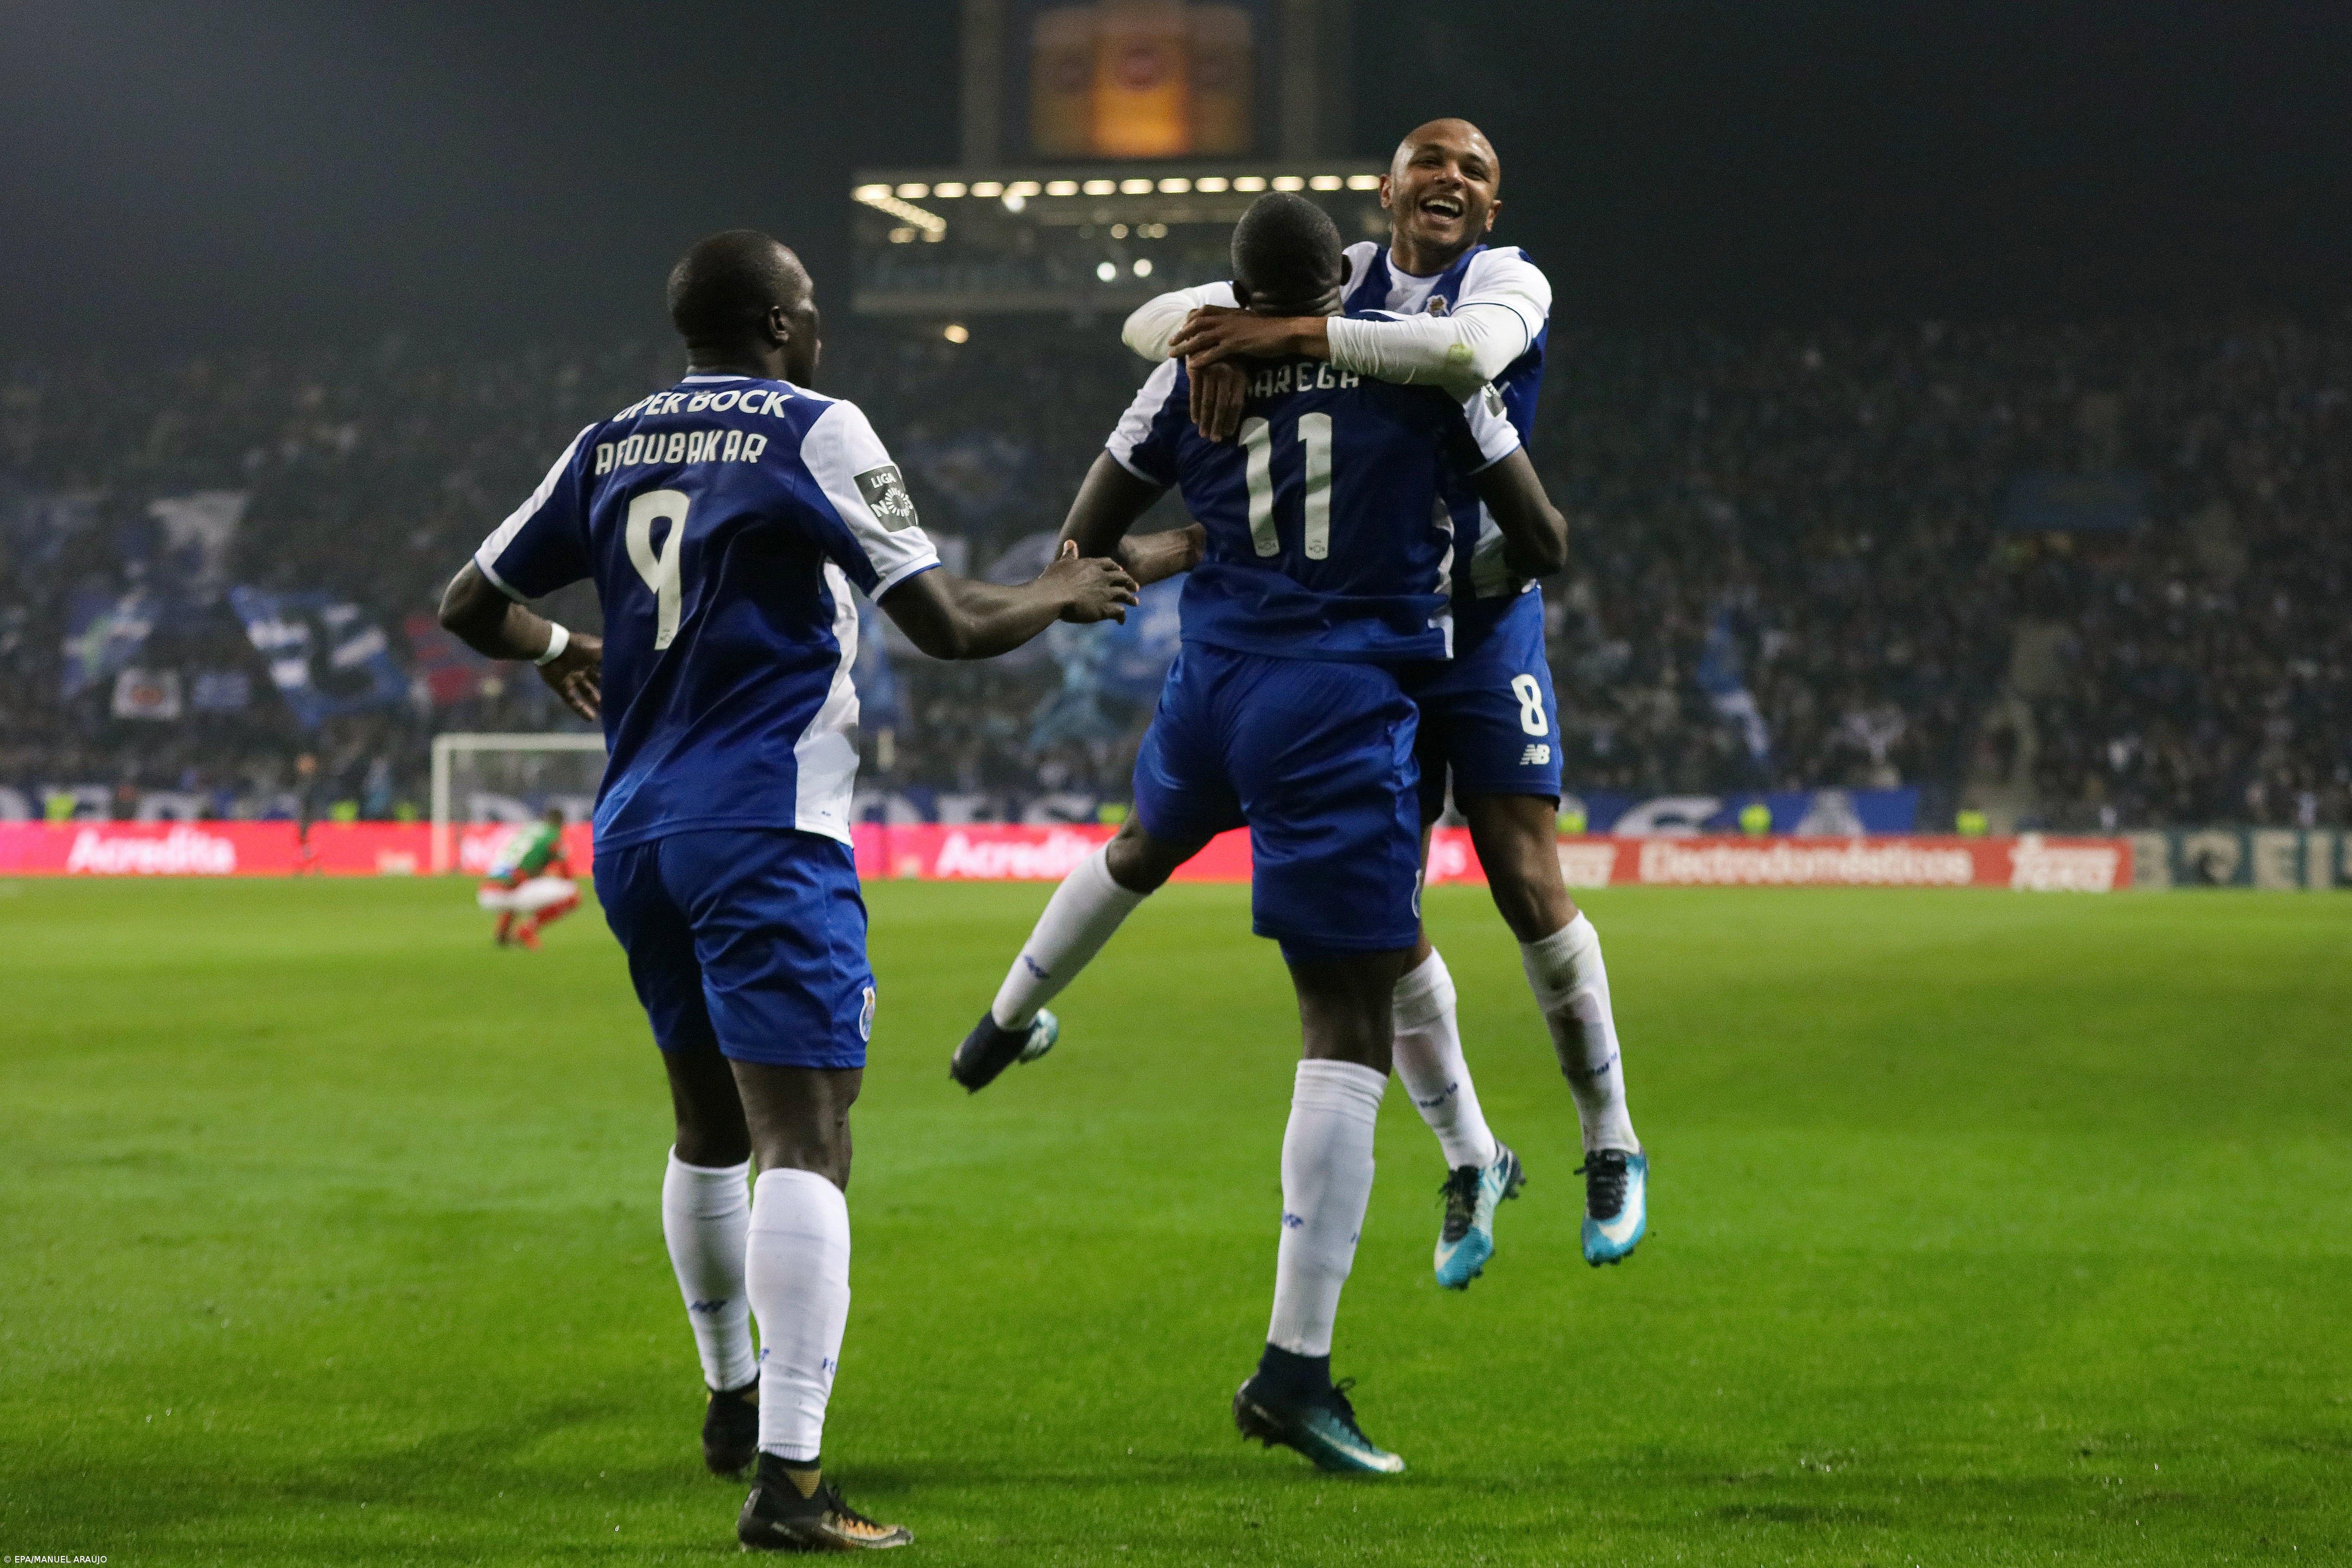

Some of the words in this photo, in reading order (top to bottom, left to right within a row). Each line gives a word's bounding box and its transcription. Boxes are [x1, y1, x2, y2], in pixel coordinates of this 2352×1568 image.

[686, 389, 795, 418] BOCK
[1246, 362, 1359, 398] AREGA
[870, 473, 897, 489] LIGA
[1238, 412, 1332, 560] 11
[625, 489, 691, 650] 9
[1511, 673, 1549, 736] 8
